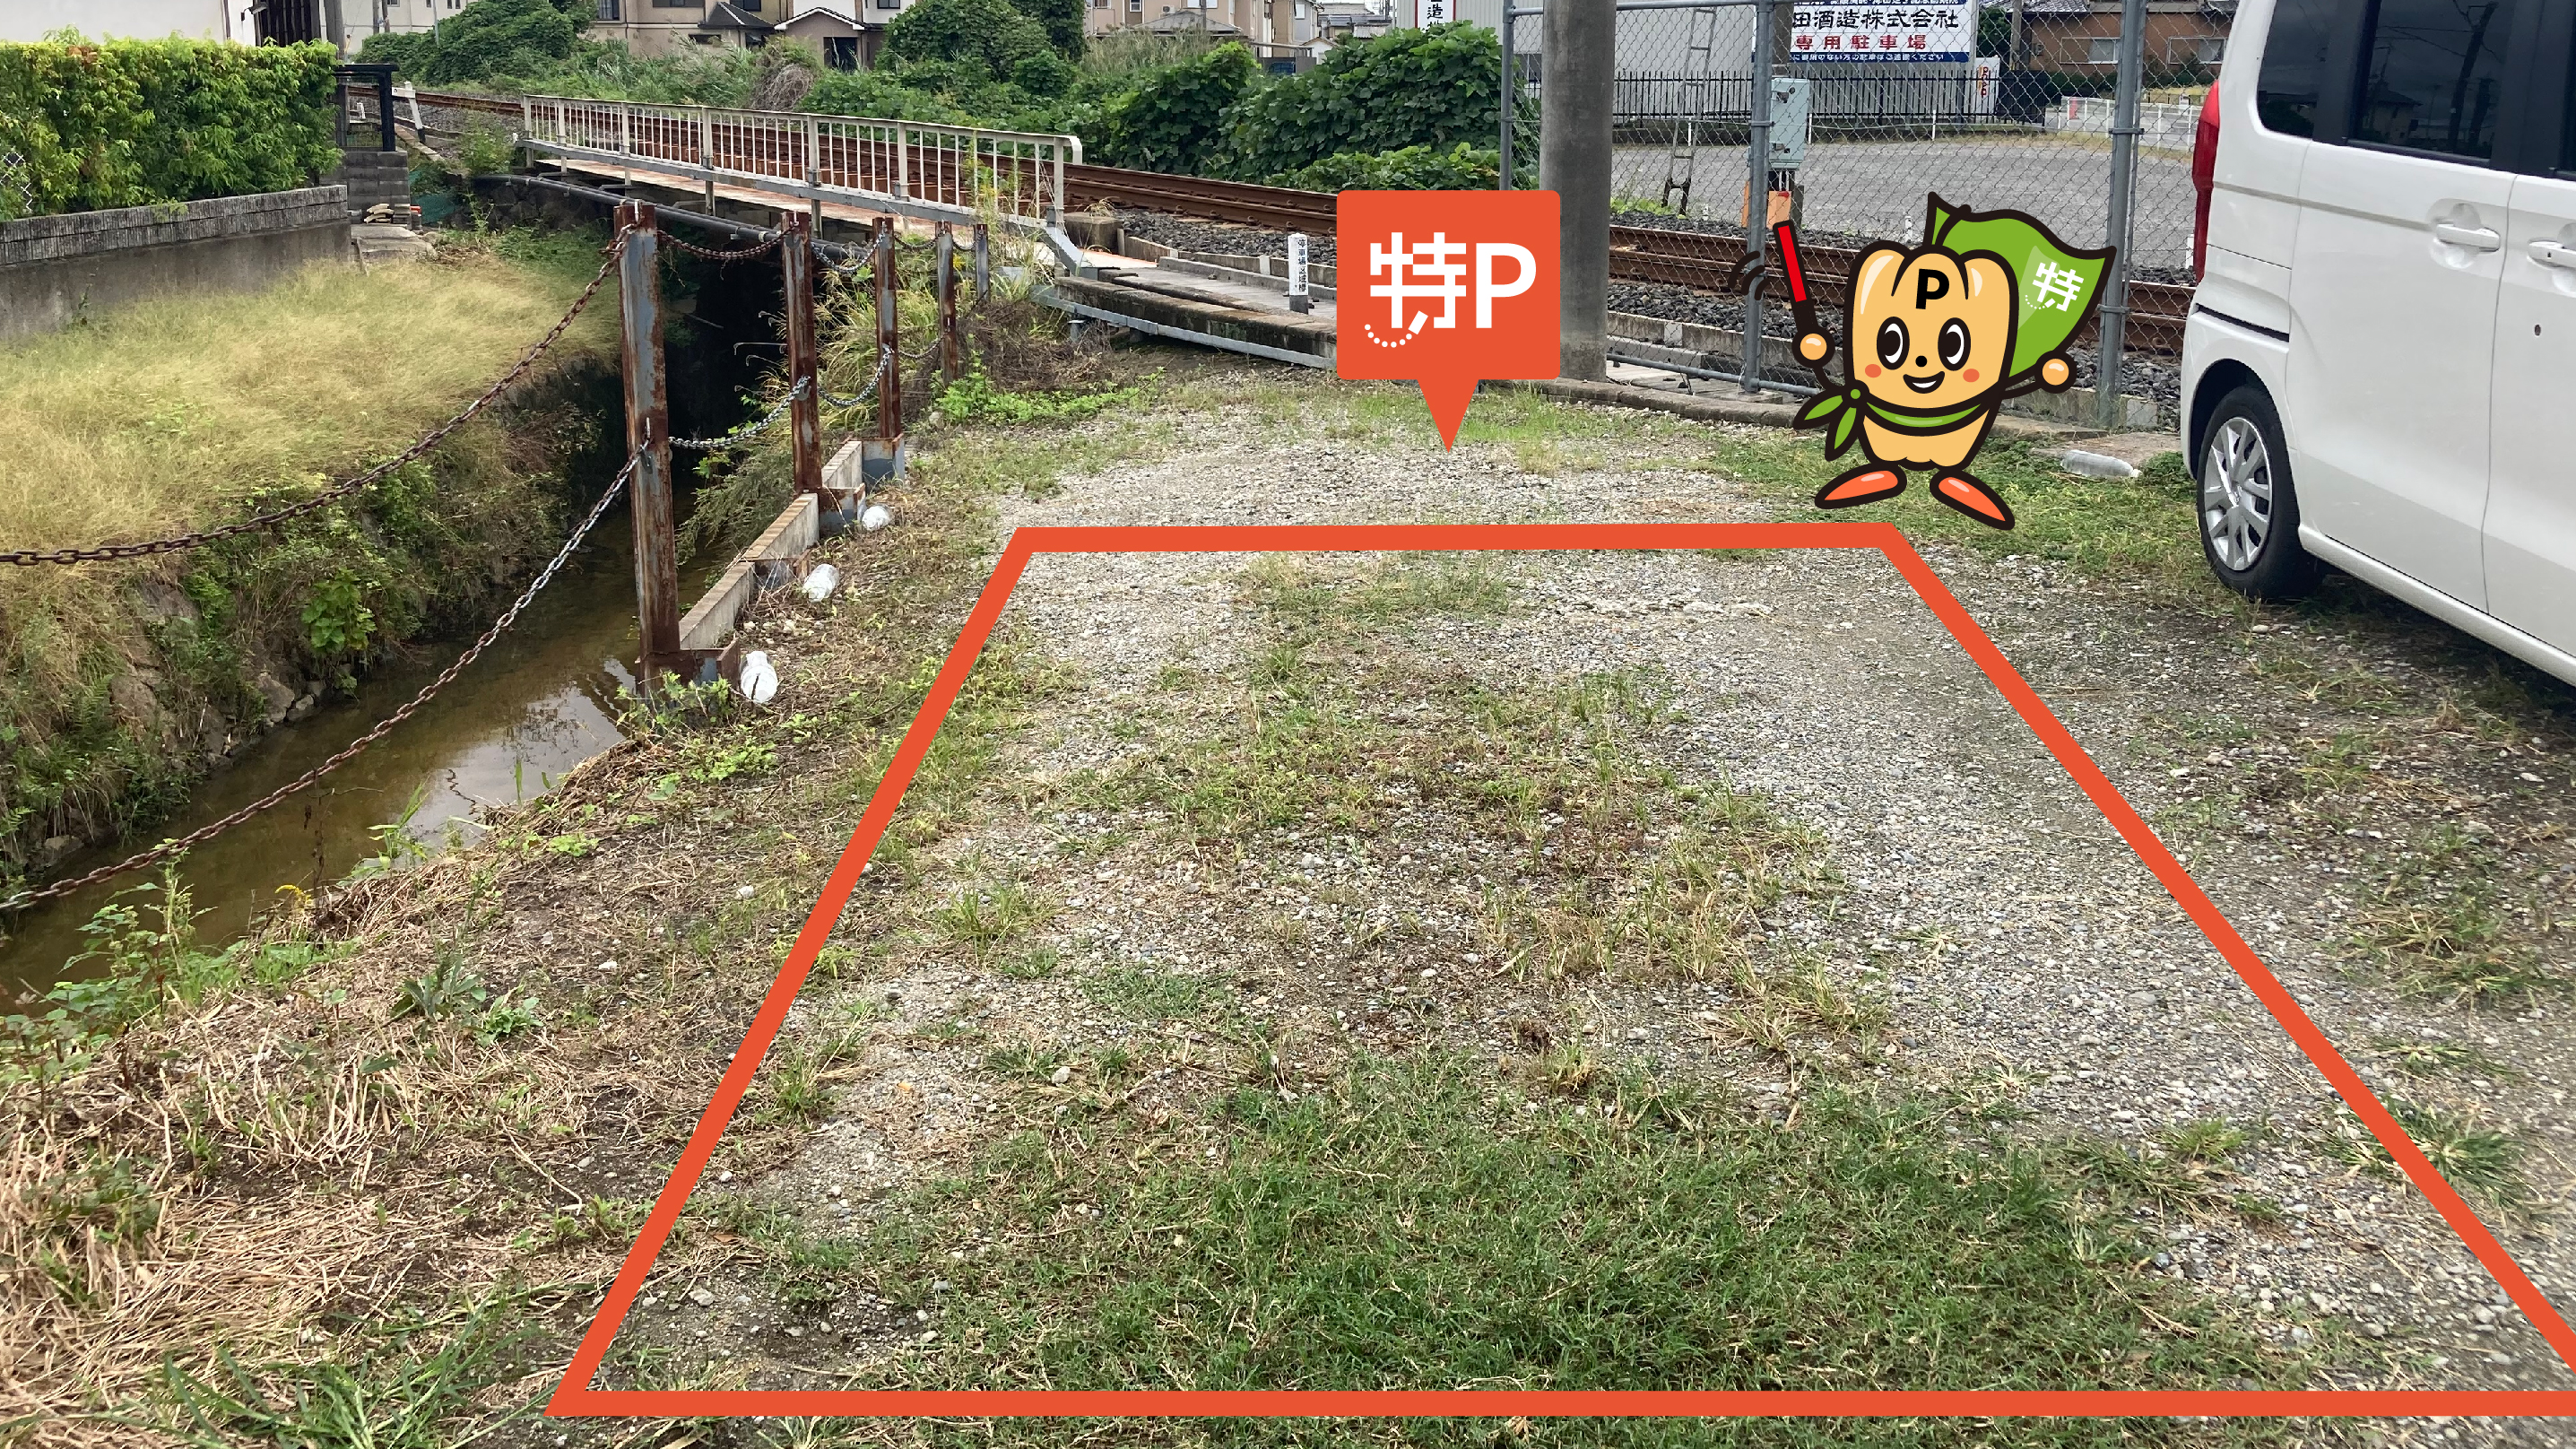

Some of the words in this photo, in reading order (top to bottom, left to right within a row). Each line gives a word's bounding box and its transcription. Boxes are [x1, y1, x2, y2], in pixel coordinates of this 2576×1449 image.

[1796, 34, 1926, 50] 専用駐車場
